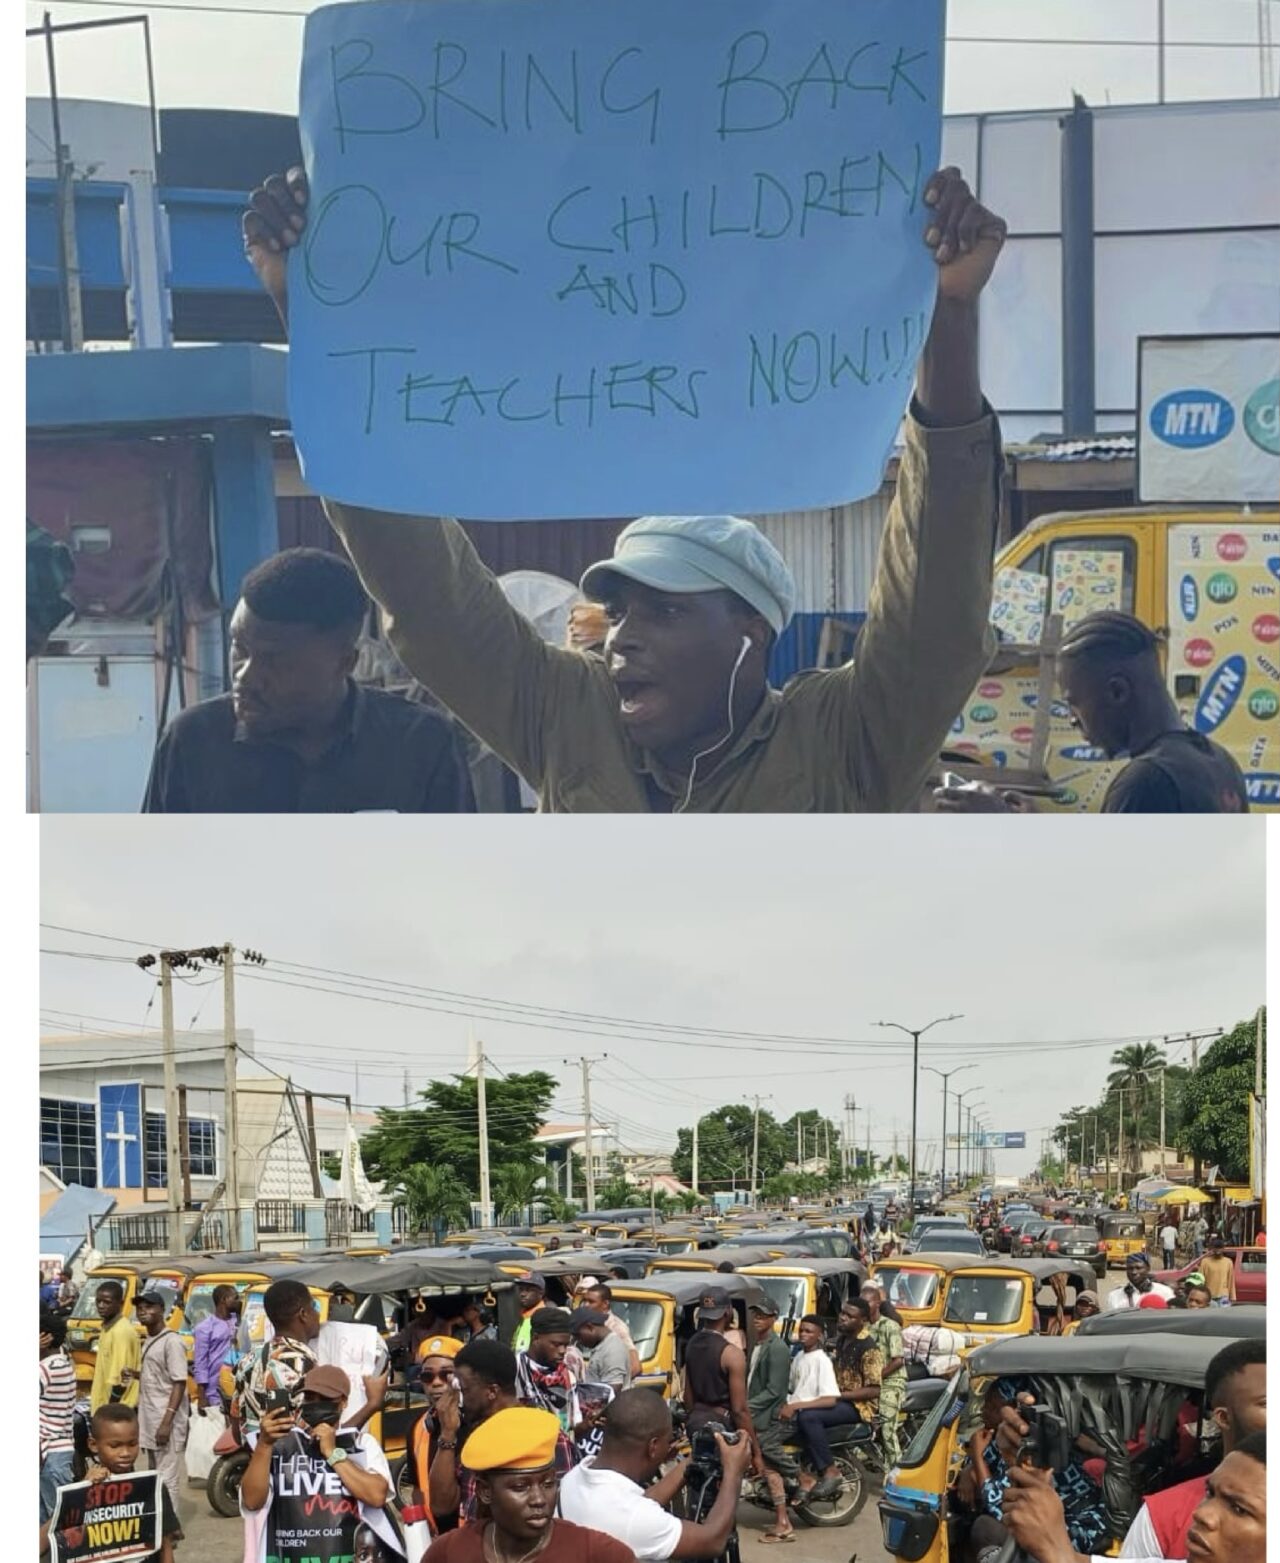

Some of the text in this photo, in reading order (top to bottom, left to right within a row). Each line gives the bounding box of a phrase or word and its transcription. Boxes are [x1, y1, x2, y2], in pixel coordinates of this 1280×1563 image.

[330, 31, 928, 154] BRING BACK
[304, 143, 921, 306] OUR CHILDREN
[557, 263, 686, 317] AND
[327, 348, 708, 435] TEACHERS
[1164, 401, 1220, 436] MTN
[1210, 579, 1235, 600] glo
[1201, 666, 1240, 725] MTN
[1250, 696, 1277, 716] glo
[85, 1481, 134, 1508] STOP
[84, 1502, 145, 1525] INSECURITY
[86, 1518, 140, 1548] NOW!
[297, 1528, 321, 1538] BACK
[323, 1527, 343, 1537] OUR
